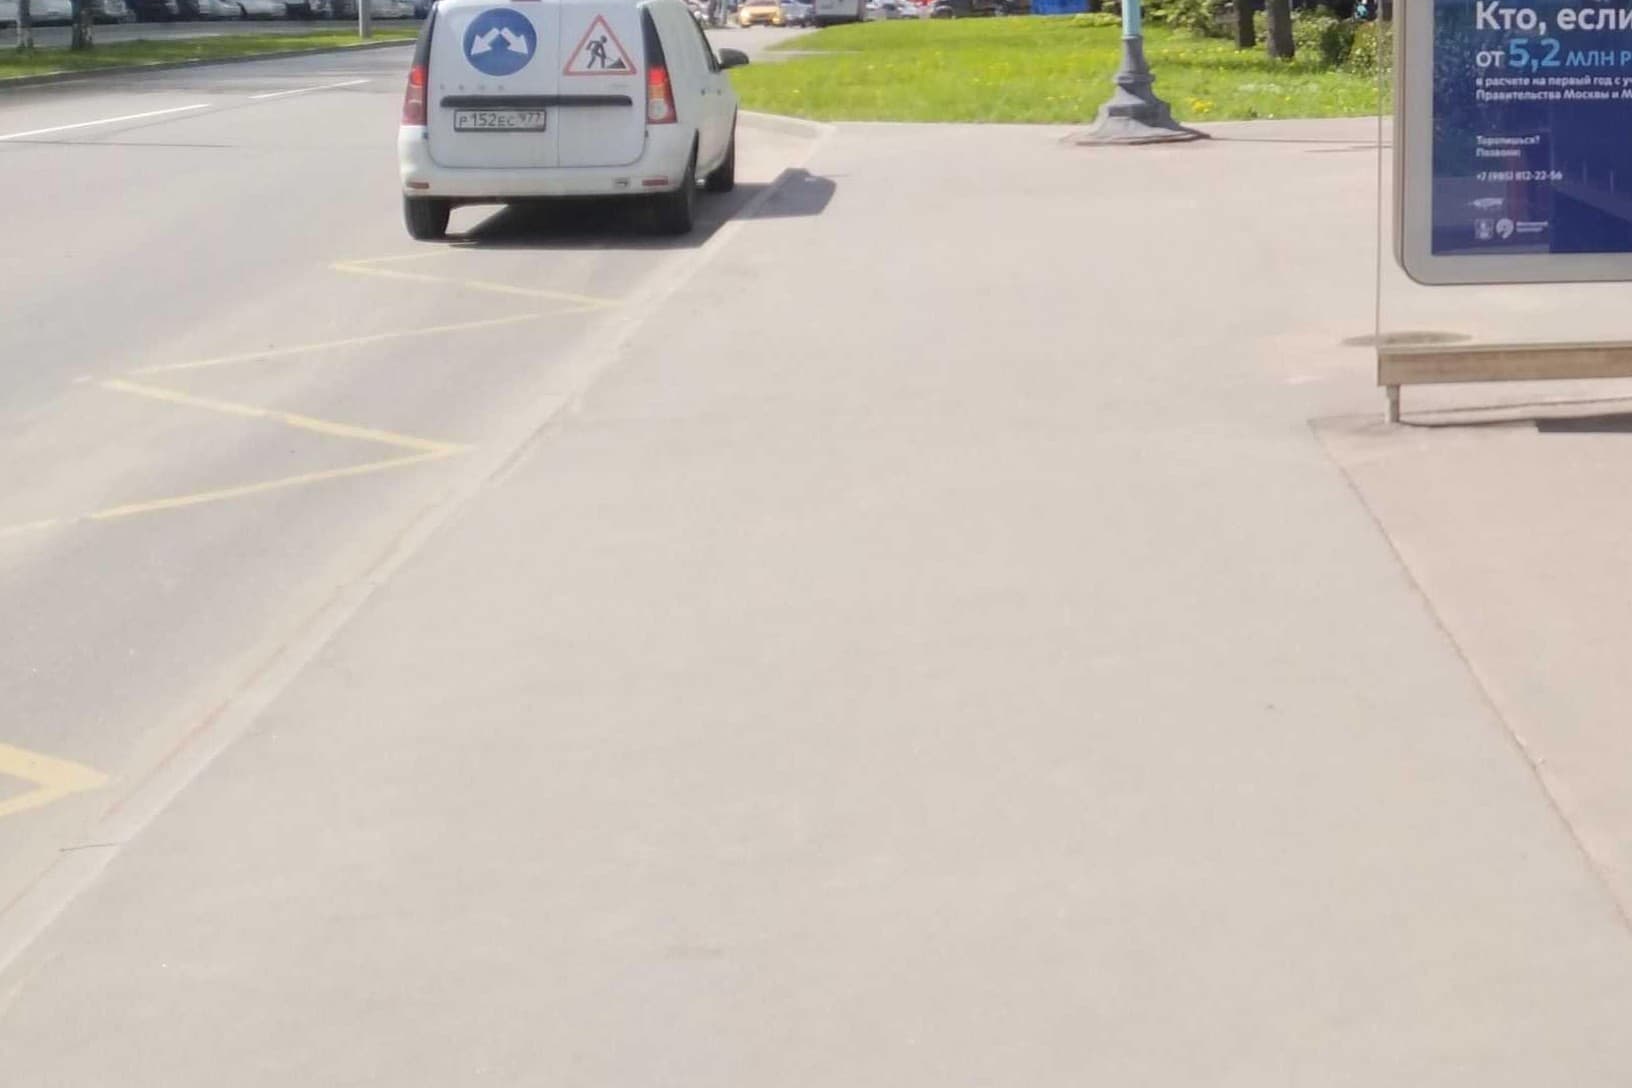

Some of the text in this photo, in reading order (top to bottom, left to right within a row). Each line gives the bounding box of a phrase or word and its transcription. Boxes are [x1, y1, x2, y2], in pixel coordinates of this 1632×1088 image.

[1475, 0, 1547, 36] Кто,
[1508, 38, 1561, 73] 5,2
[1565, 50, 1614, 67] МЛН
[1548, 74, 1591, 88] первый
[1593, 77, 1613, 87] год
[1476, 90, 1561, 102] Правительства
[1563, 89, 1609, 100] Москвы
